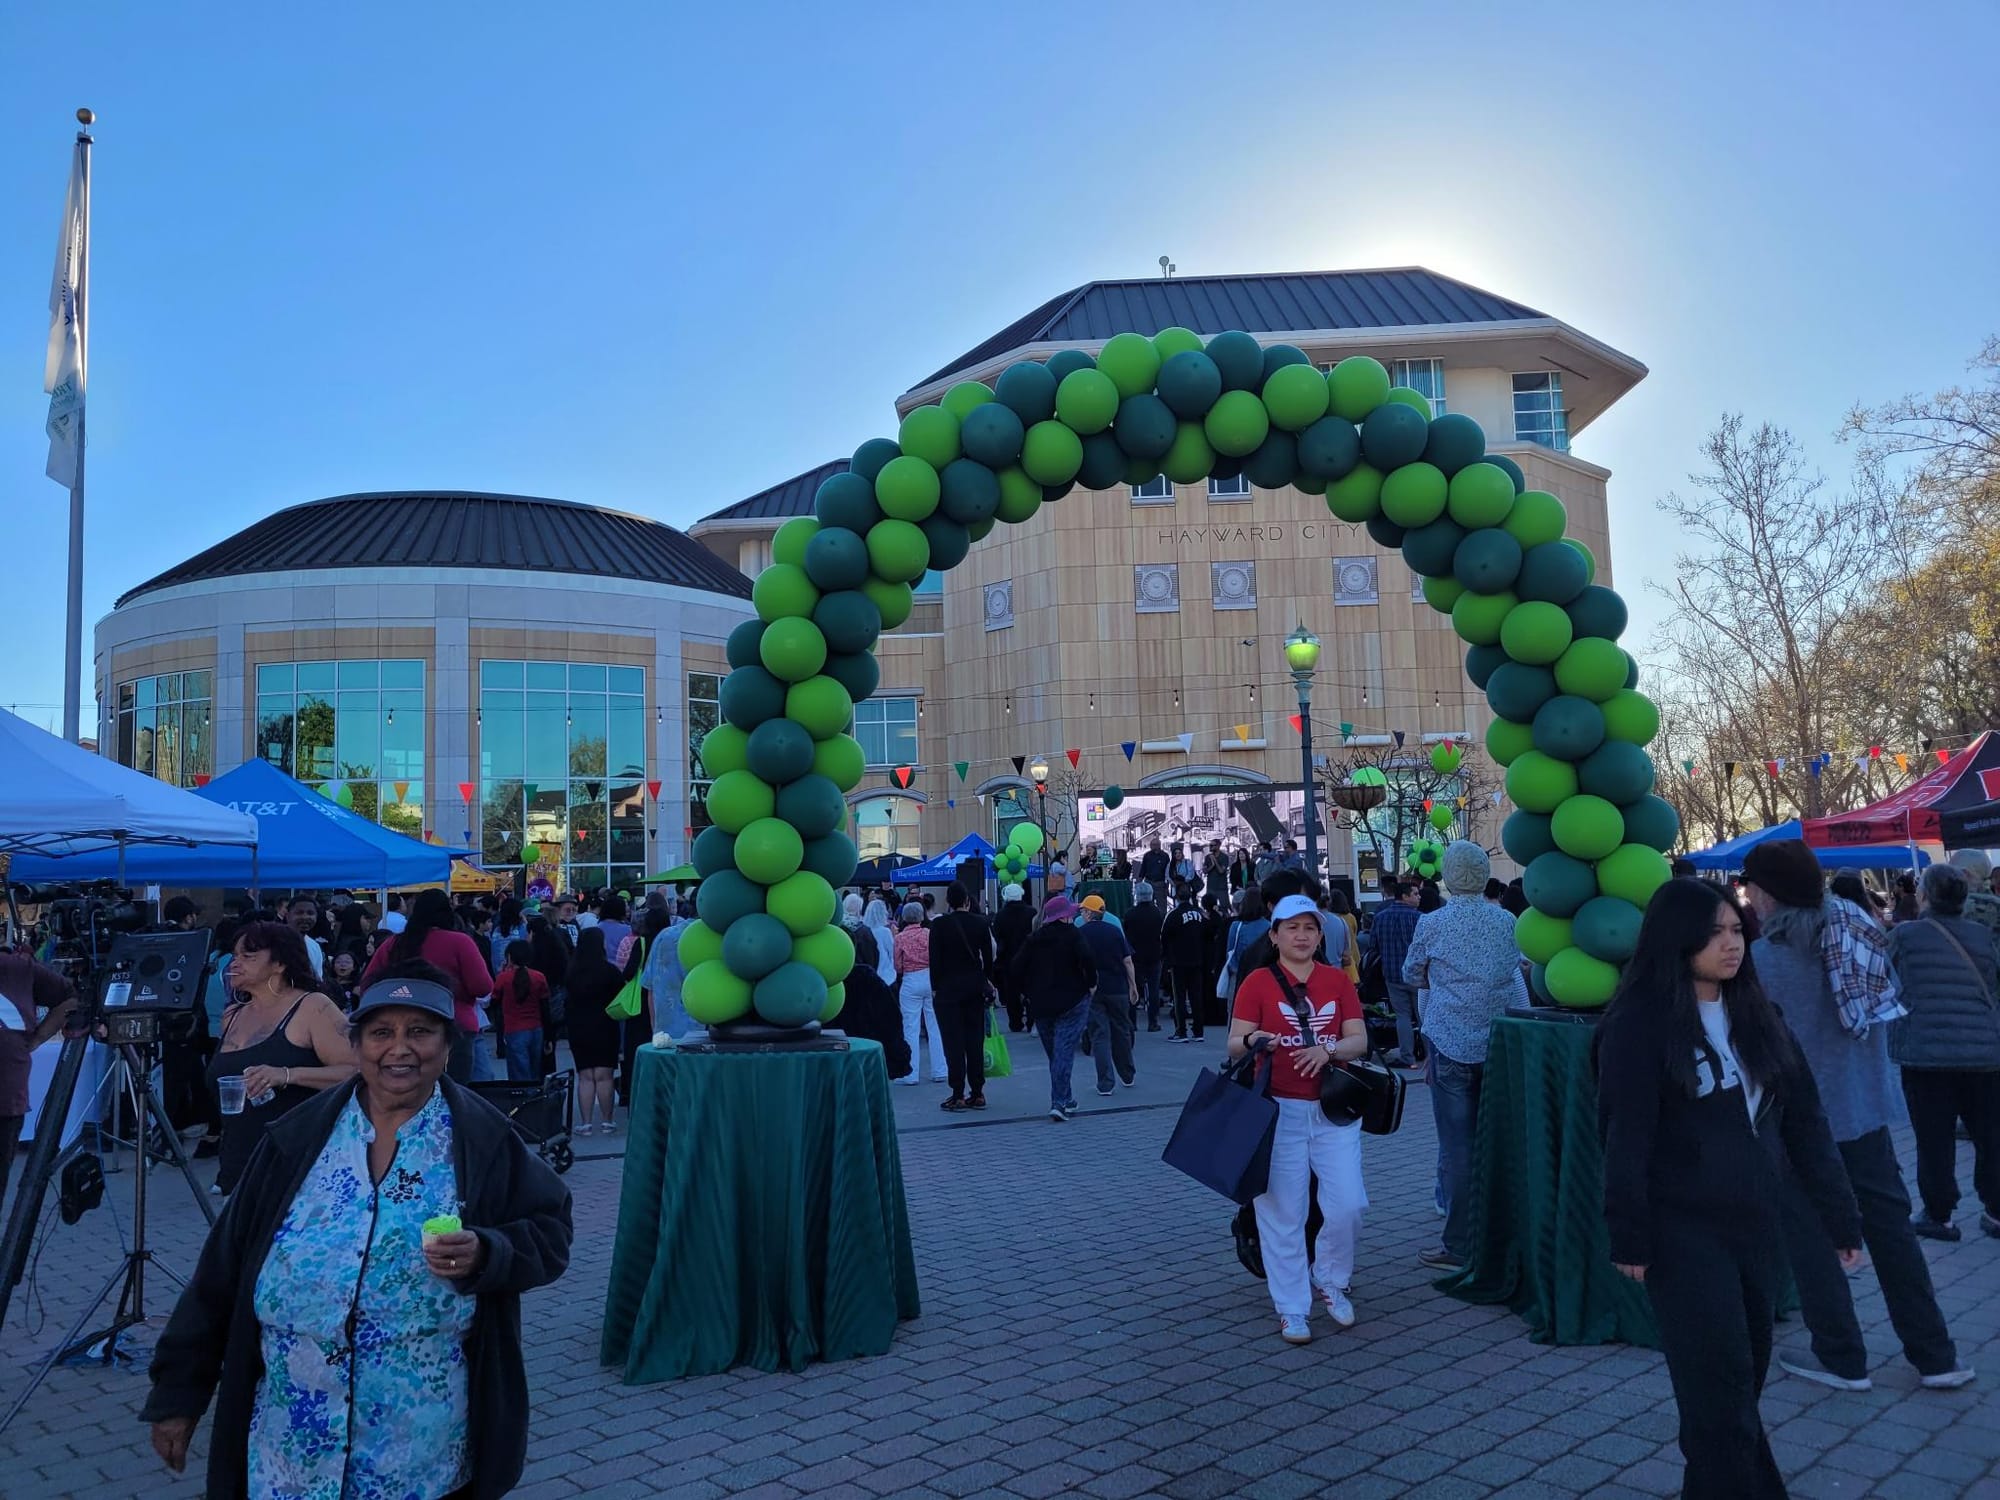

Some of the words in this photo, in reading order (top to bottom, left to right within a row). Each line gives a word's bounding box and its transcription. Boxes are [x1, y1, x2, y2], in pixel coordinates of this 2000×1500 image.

[1158, 526, 1283, 544] HAYWARD
[1302, 524, 1360, 539] CITY
[225, 801, 298, 816] AT&T
[1280, 1031, 1337, 1047] adas
